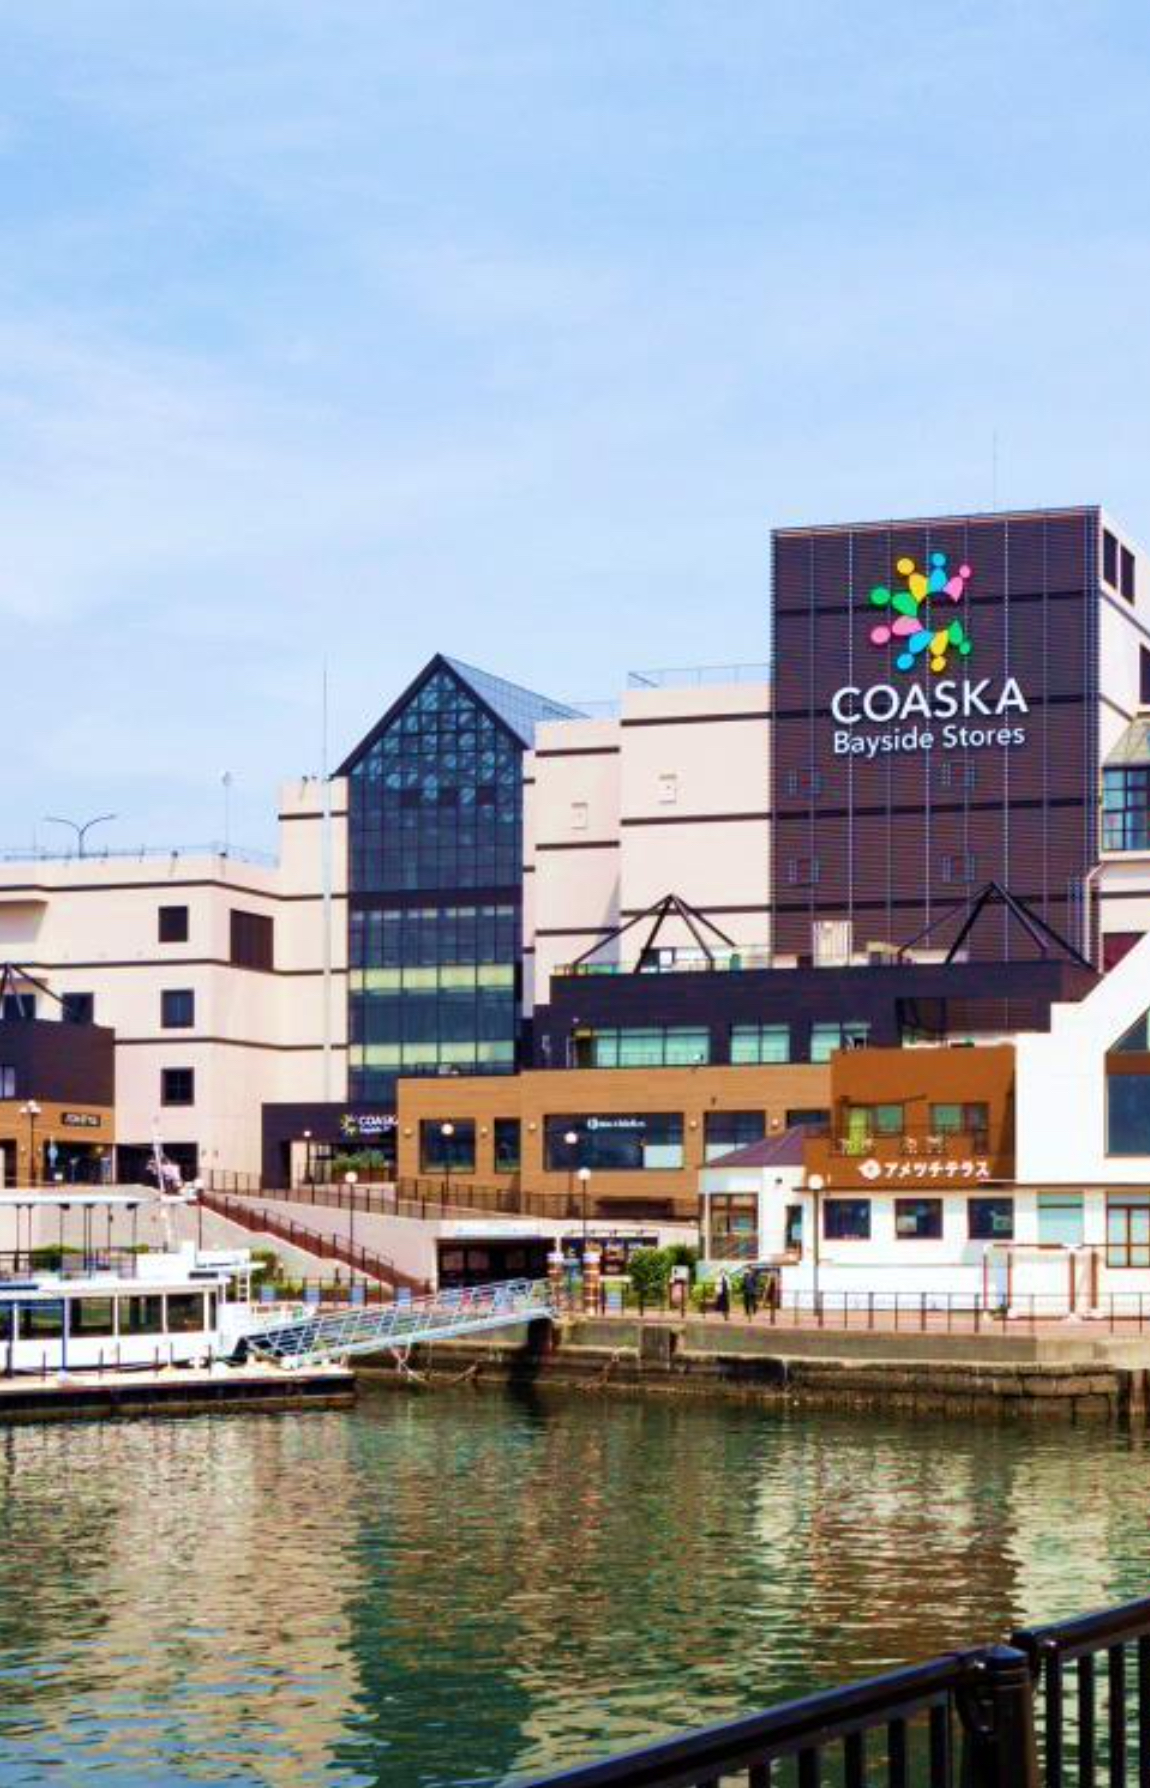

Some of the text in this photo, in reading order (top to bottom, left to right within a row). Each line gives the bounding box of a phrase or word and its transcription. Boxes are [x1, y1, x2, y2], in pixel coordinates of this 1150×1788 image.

[831, 677, 1029, 724] COASKA
[833, 724, 1026, 758] Bayside Stores
[884, 1160, 990, 1178] アメツチテラス
